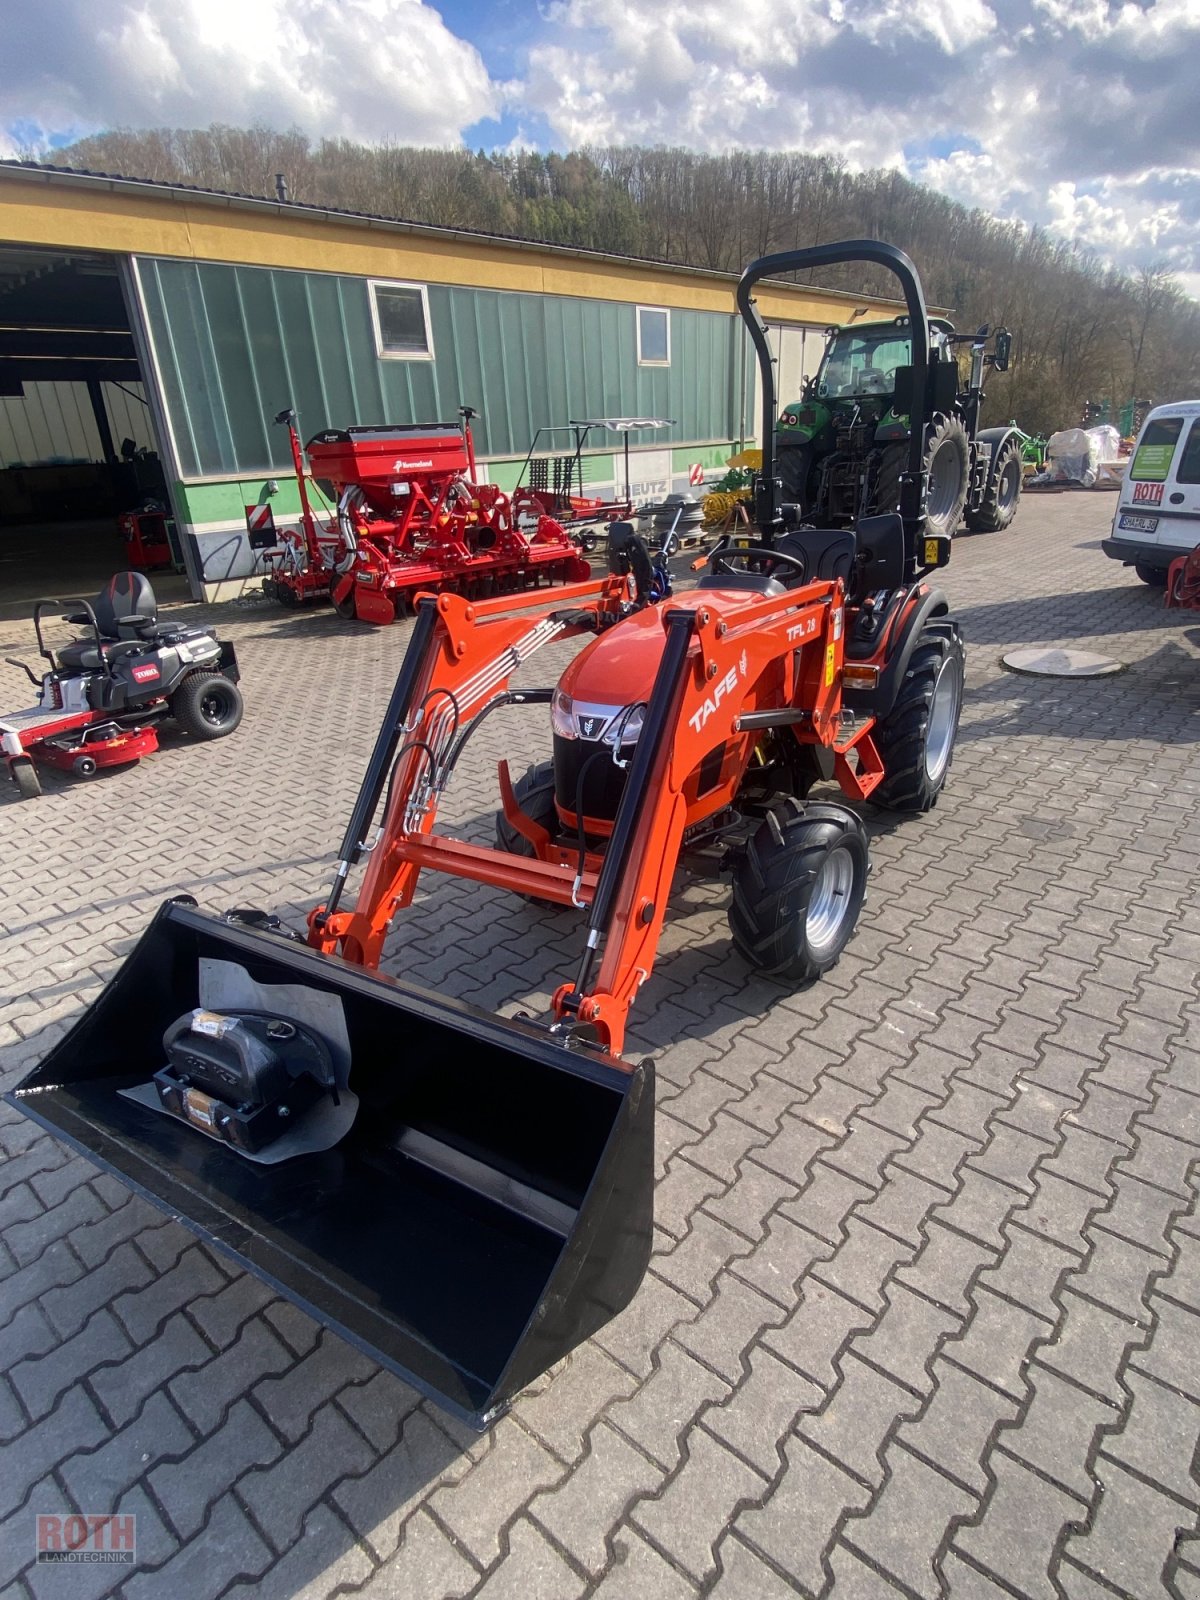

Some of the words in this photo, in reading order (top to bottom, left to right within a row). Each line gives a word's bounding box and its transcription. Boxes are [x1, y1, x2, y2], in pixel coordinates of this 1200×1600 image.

[1134, 483, 1164, 500] ROTH
[786, 624, 805, 642] TFL
[807, 618, 816, 634] 28
[689, 665, 738, 733] TAFE
